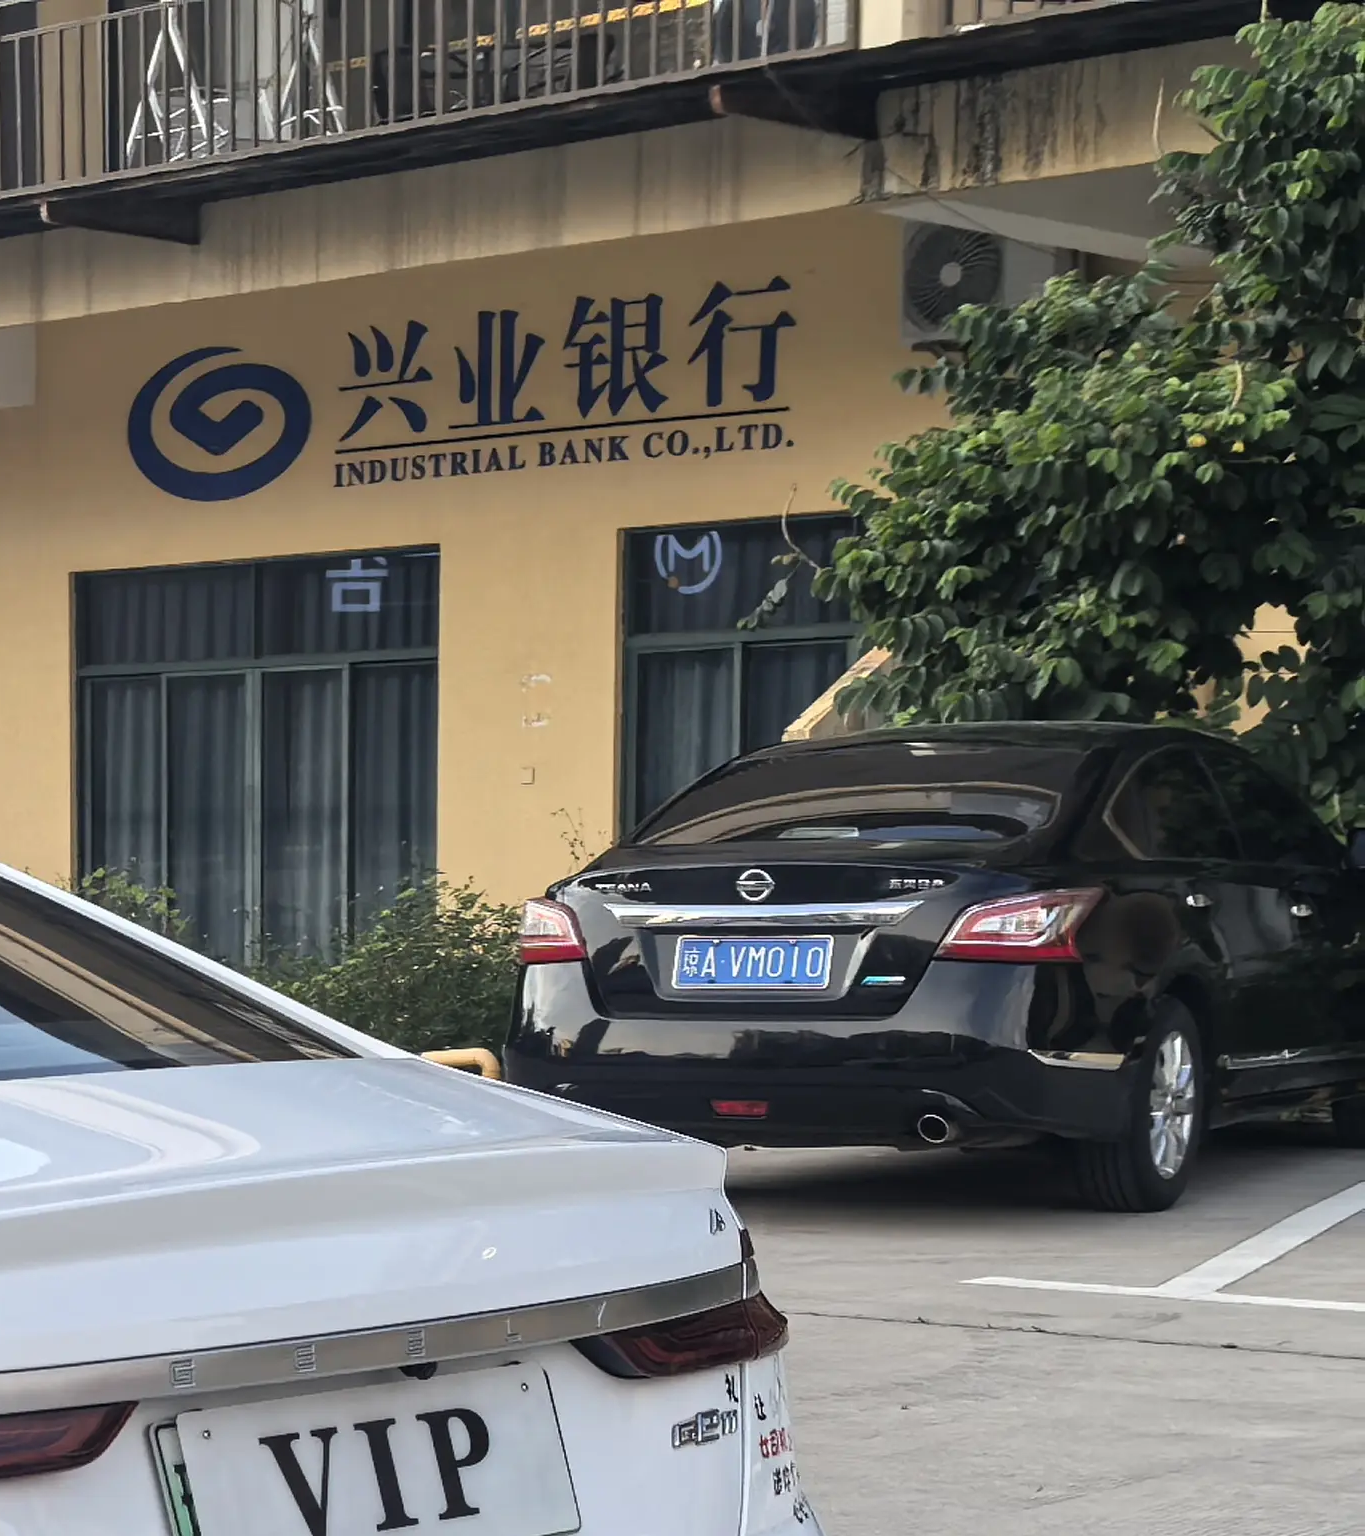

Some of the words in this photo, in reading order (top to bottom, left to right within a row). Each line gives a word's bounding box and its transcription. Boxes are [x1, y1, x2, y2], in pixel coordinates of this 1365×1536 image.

[339, 276, 797, 442] 兴业银行
[334, 444, 526, 488] INDUSTRIAL
[538, 434, 630, 468] BANK
[642, 421, 795, 459] CO.,LTD.
[170, 1300, 607, 1388] GEELY
